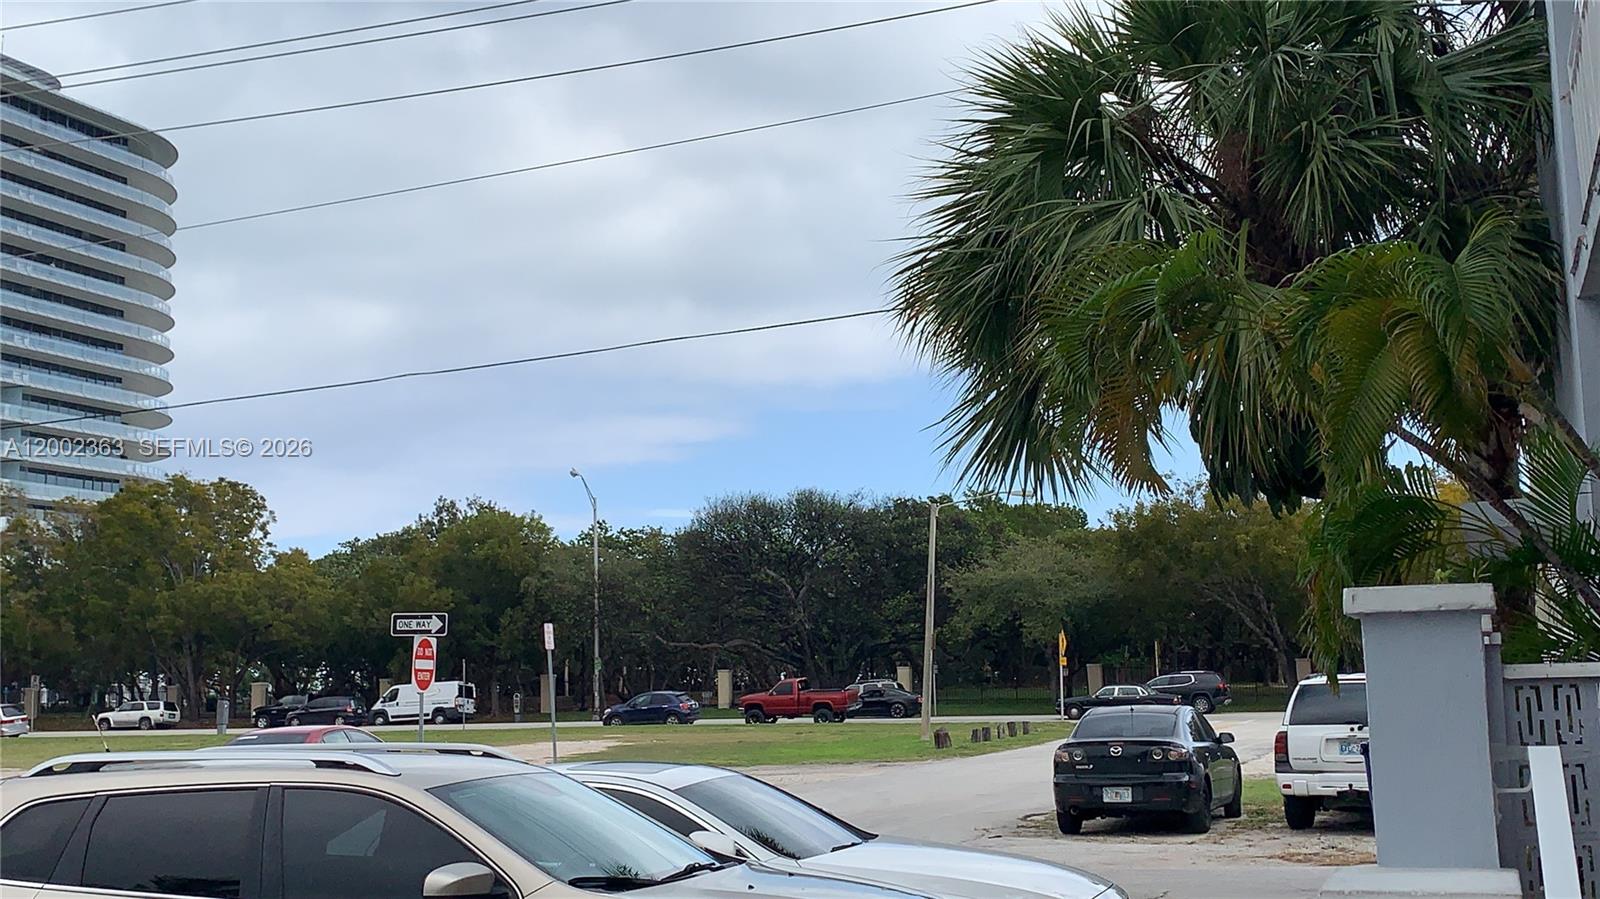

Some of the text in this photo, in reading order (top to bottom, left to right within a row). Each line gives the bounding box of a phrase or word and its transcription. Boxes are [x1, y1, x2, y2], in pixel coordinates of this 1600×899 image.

[398, 621, 432, 629] ONE WAY
[417, 647, 424, 656] DO
[417, 672, 430, 681] ENTER
